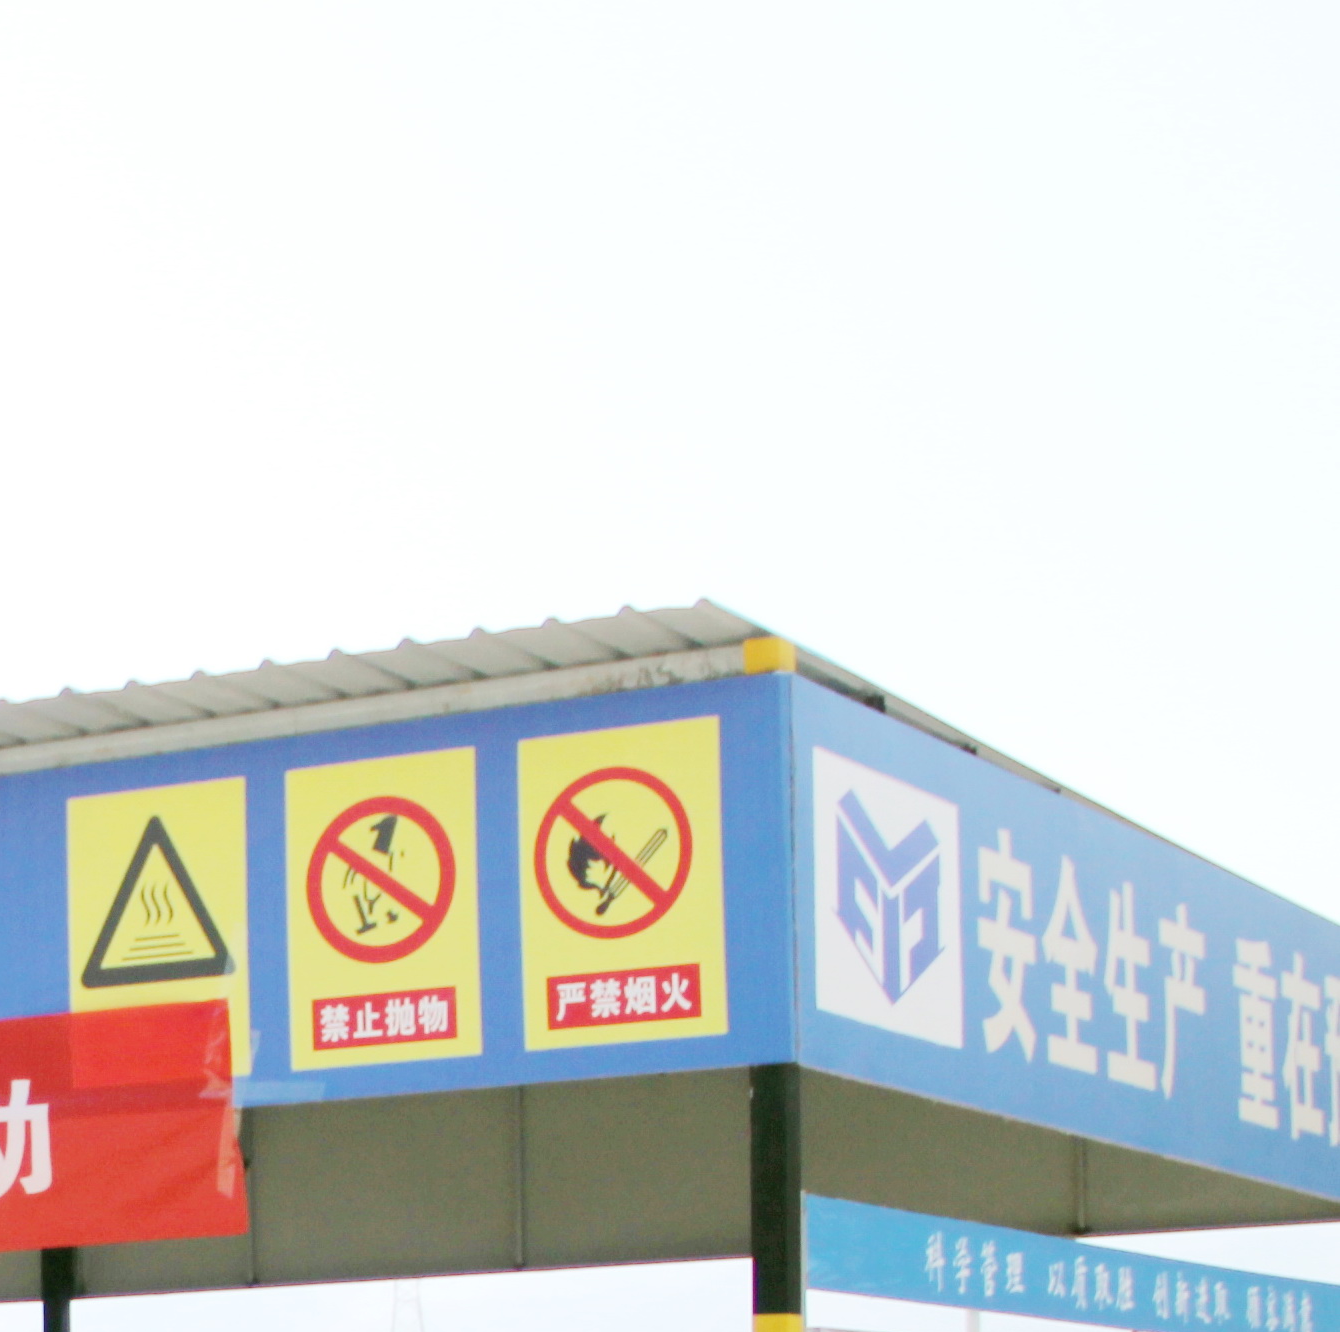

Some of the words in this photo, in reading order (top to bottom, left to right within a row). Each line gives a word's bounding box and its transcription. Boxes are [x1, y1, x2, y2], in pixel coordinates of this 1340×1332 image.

[978, 828, 1207, 1100] 安全生产
[319, 992, 450, 1044] 禁止抛物
[555, 971, 693, 1023] 严禁烟火
[925, 1231, 1027, 1298] 科学管理
